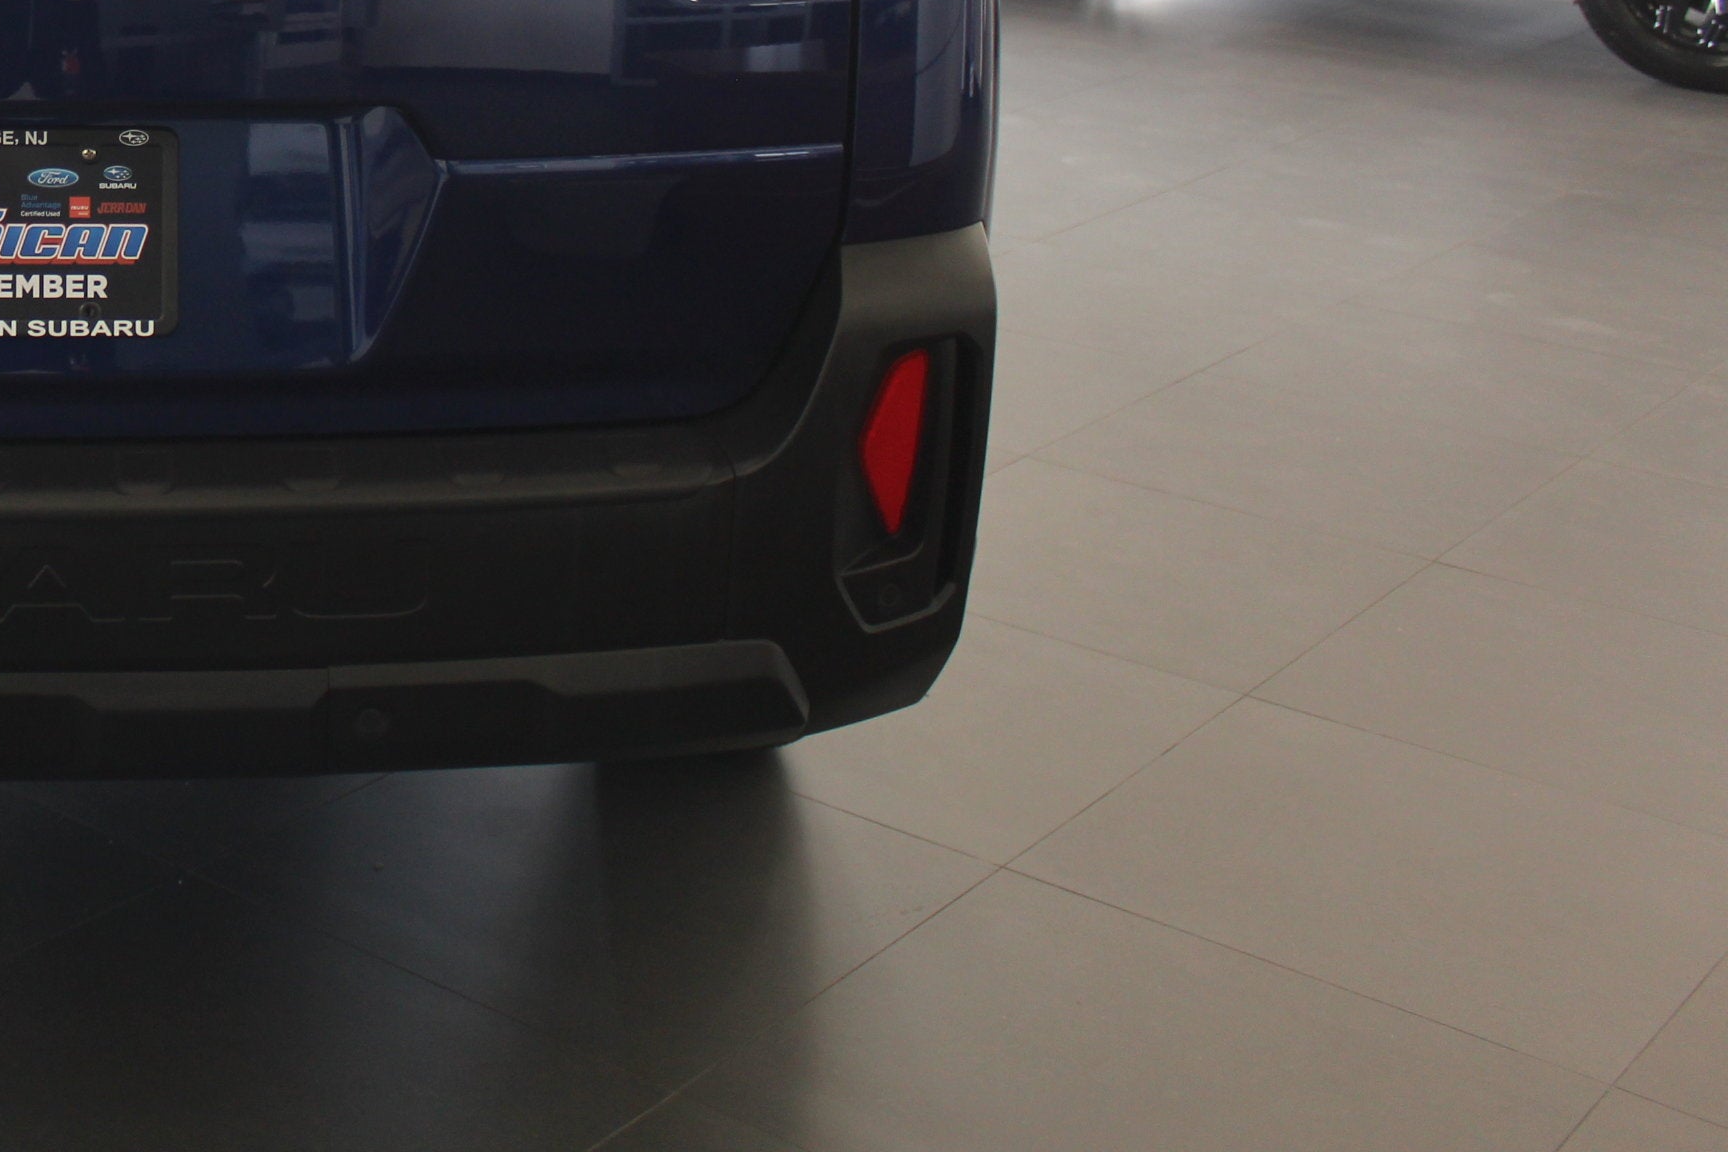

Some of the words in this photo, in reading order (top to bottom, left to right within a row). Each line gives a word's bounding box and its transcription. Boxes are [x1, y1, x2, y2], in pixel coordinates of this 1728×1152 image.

[25, 130, 48, 146] NJ
[37, 171, 69, 185] Ford
[99, 182, 137, 190] SUBARU
[27, 319, 155, 337] SUBARU
